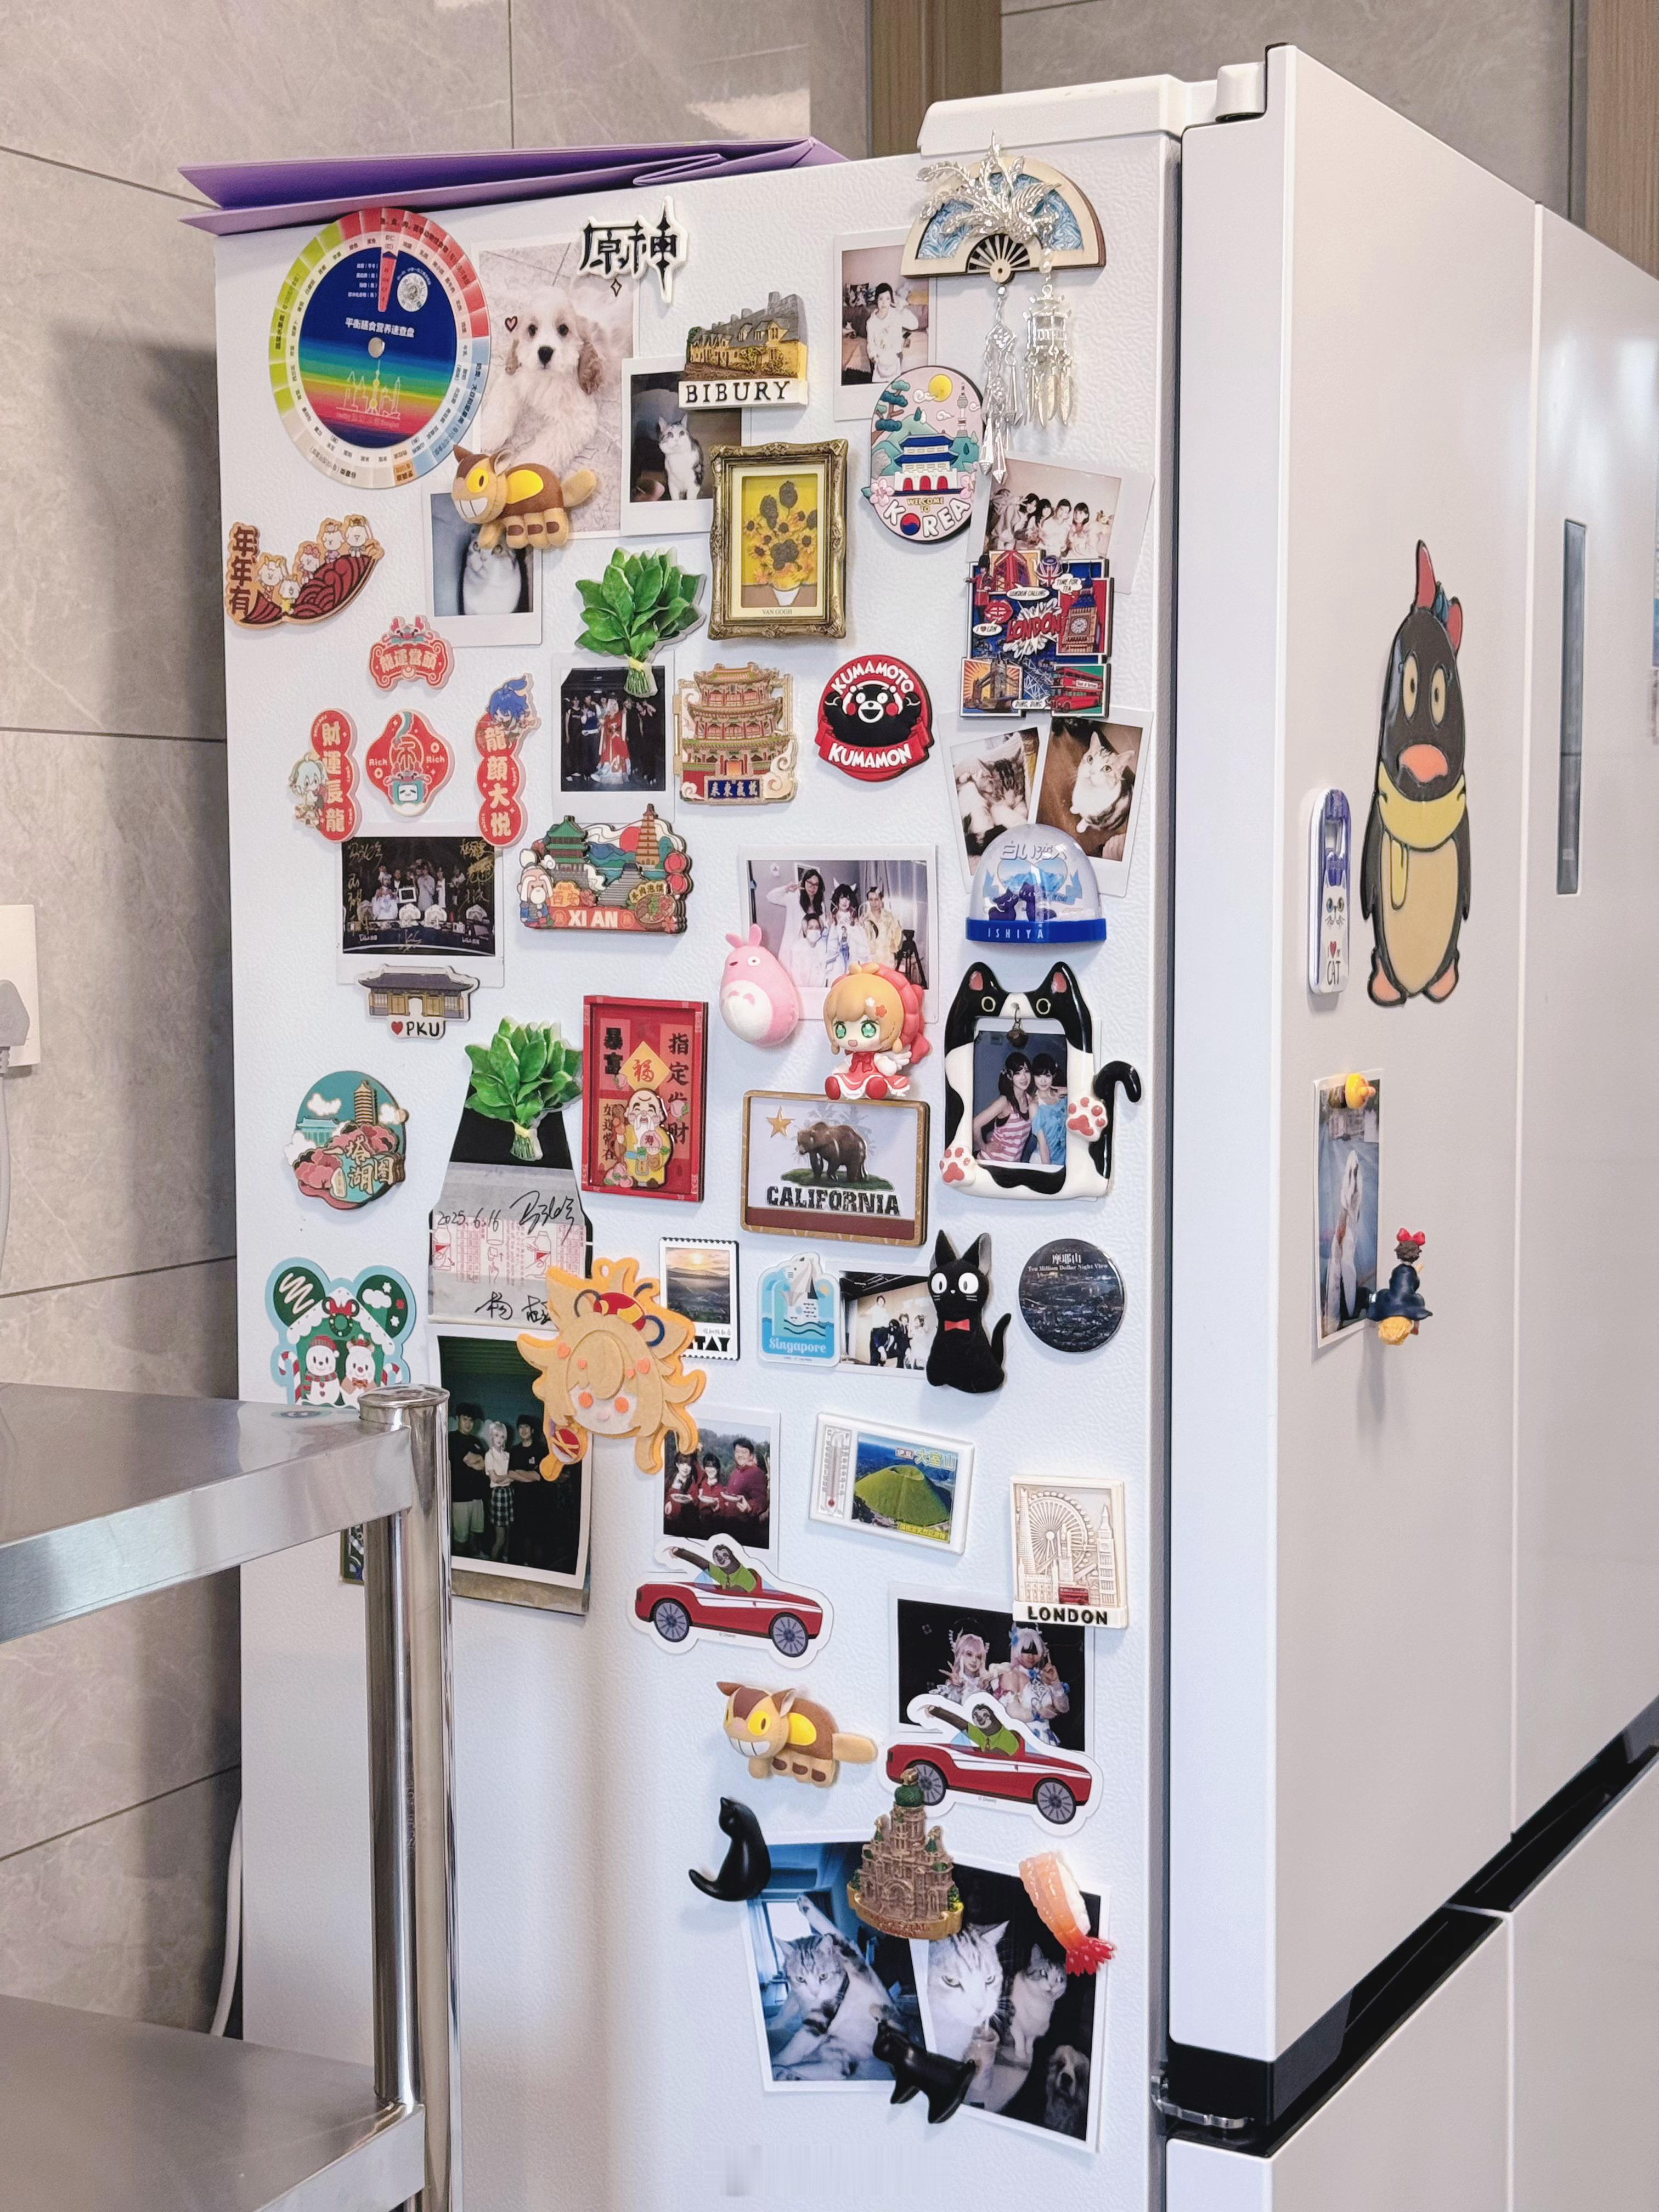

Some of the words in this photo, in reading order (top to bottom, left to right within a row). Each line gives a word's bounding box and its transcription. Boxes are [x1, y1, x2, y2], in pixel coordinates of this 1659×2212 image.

[580, 205, 677, 294] 原神
[686, 381, 791, 403] BIBURY
[906, 496, 944, 506] WELCOME
[831, 660, 915, 695] KUMAMOTO
[828, 743, 912, 768] KUMAMON
[568, 909, 587, 927] XI
[590, 910, 618, 928] AN
[988, 928, 1043, 939] ISHIYA
[1327, 960, 1341, 986] CAT
[406, 1021, 439, 1036] PKU
[766, 1186, 901, 1216] CALIFORNIA
[915, 1449, 955, 1470] 大室山
[1027, 1606, 1108, 1625] LONDON
